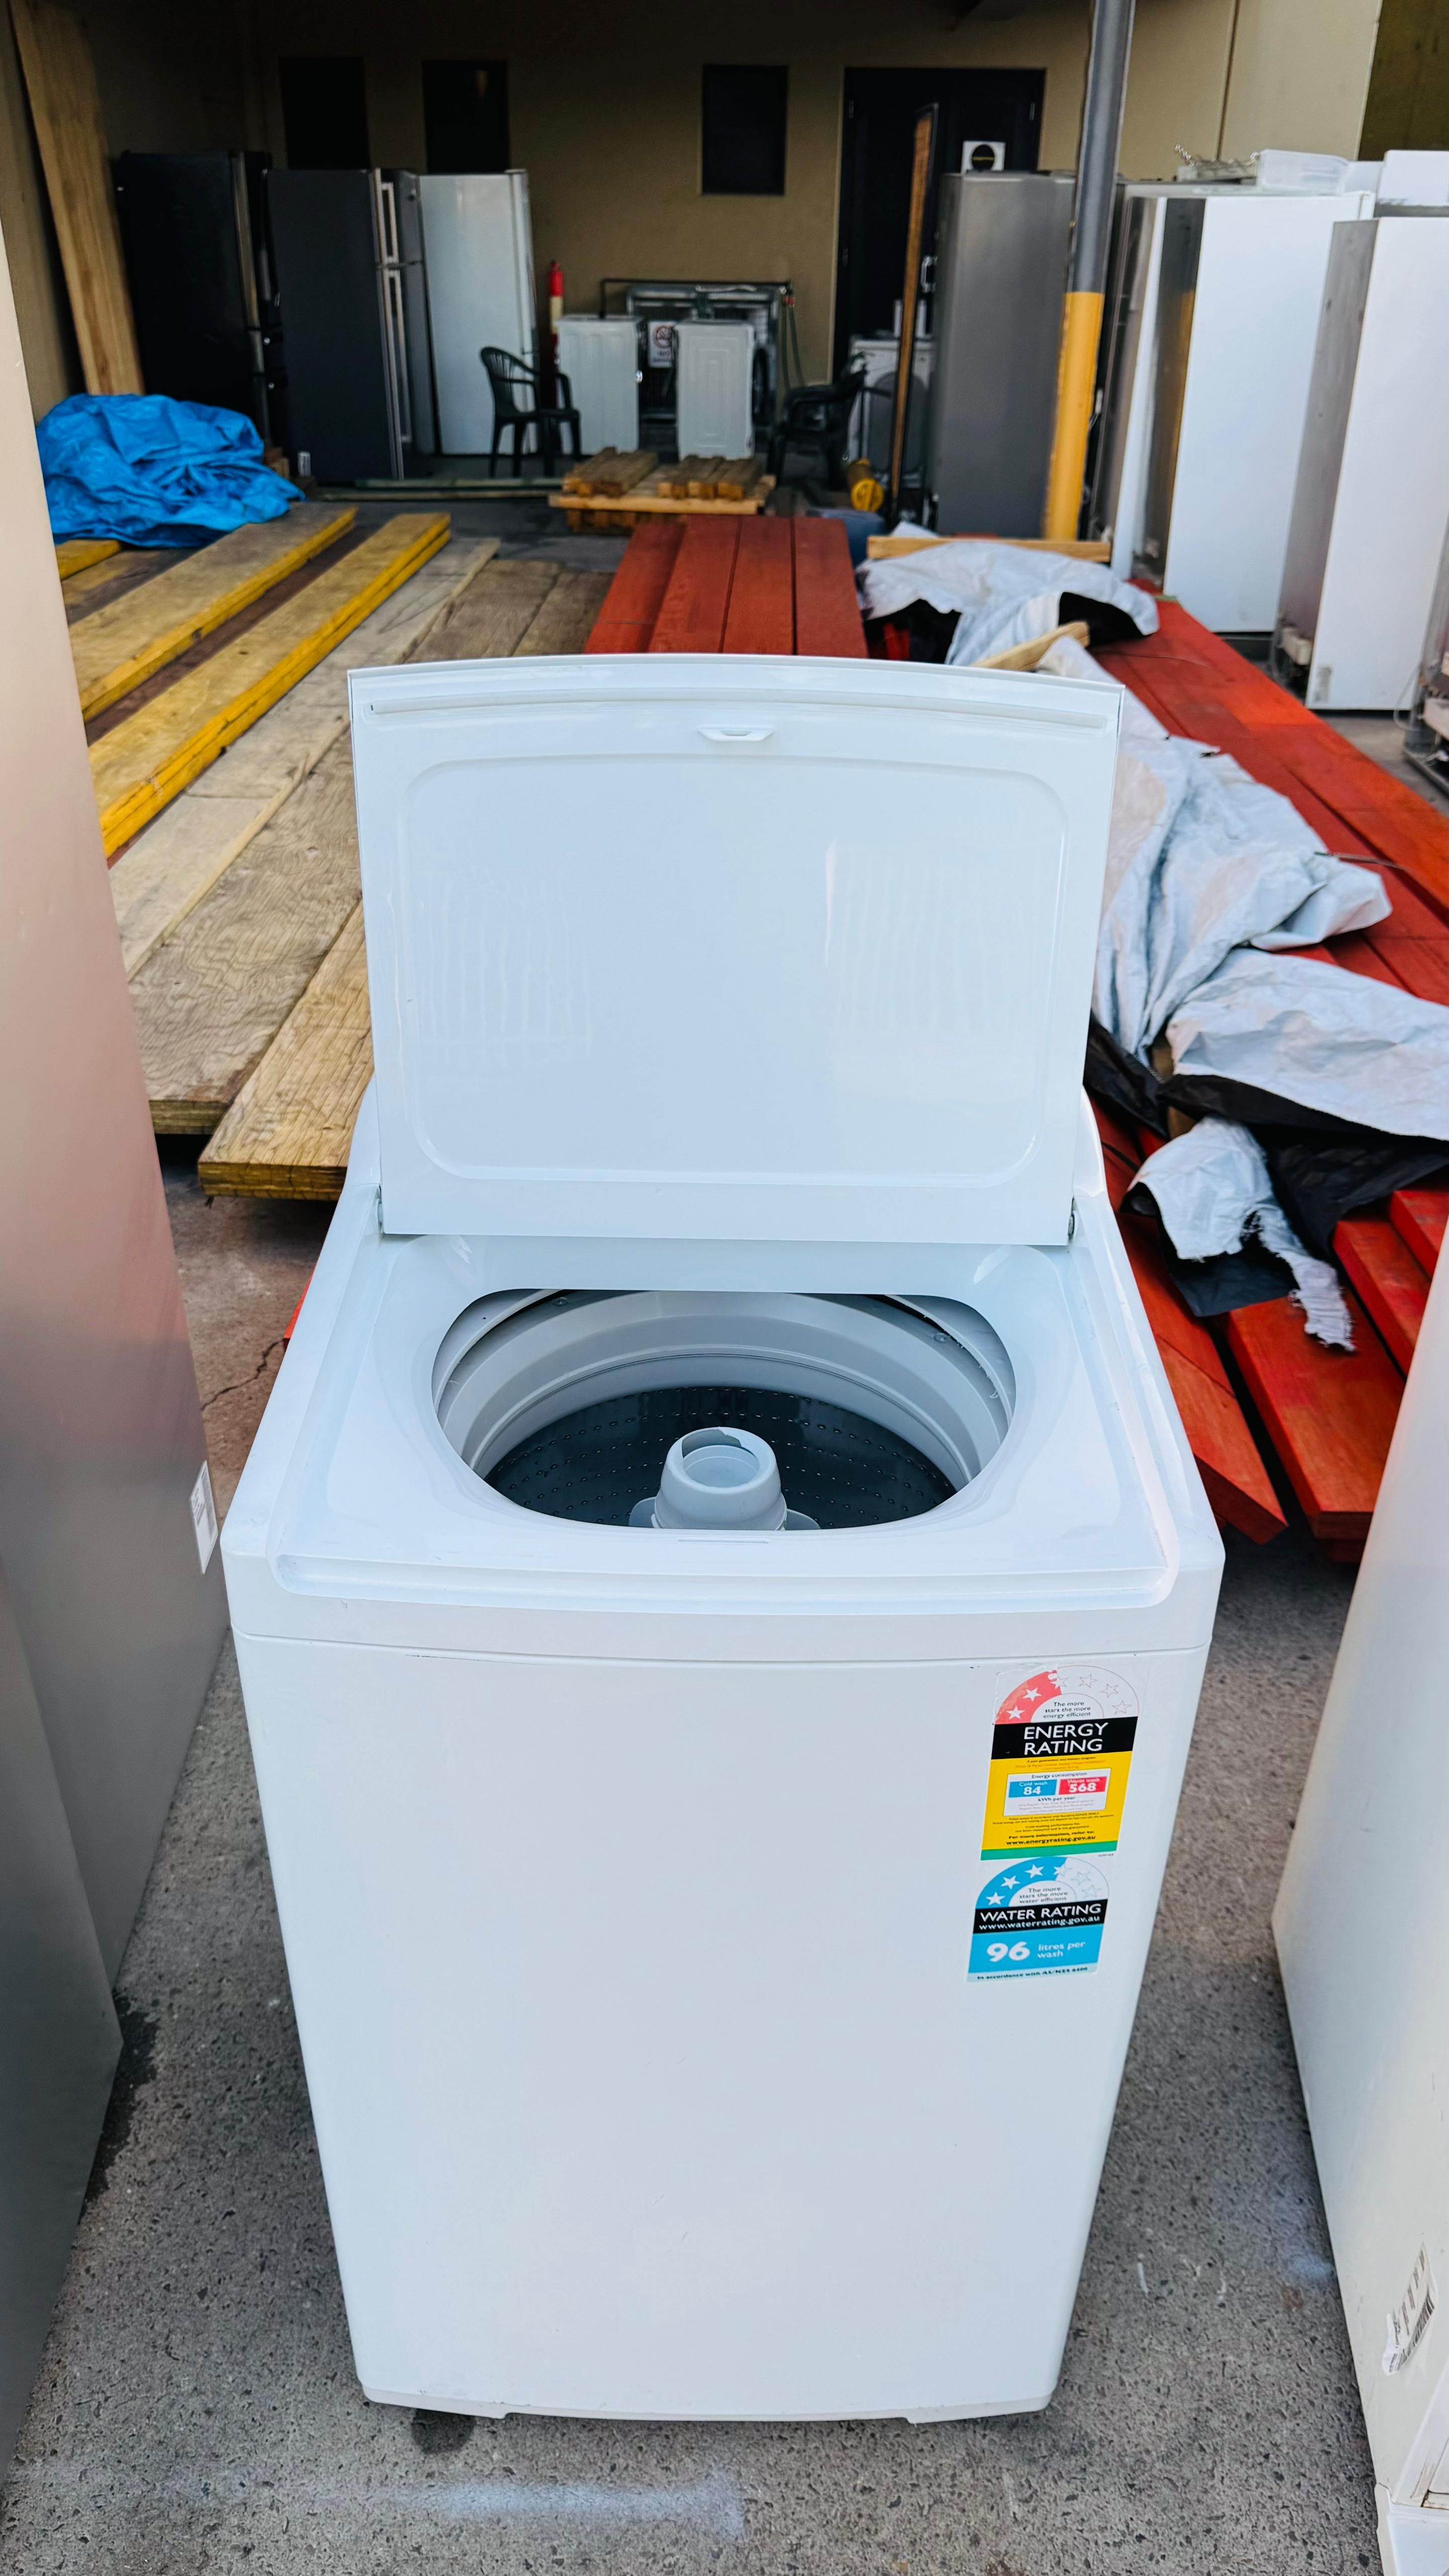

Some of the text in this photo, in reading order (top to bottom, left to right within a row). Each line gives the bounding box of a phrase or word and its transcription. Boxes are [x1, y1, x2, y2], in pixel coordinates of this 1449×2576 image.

[1024, 1722, 1108, 1740] ENERGY
[1024, 1738, 1103, 1755] RATING
[1023, 1783, 1096, 1795] 84 568
[1006, 1836, 1096, 1845] www.energyrating.gov.au
[980, 1903, 1102, 1922] WATER RATING
[979, 1915, 1100, 1930] www.waterrating.gov.au
[987, 1941, 1086, 1962] 96 litres per
[1037, 1951, 1063, 1959] wash
